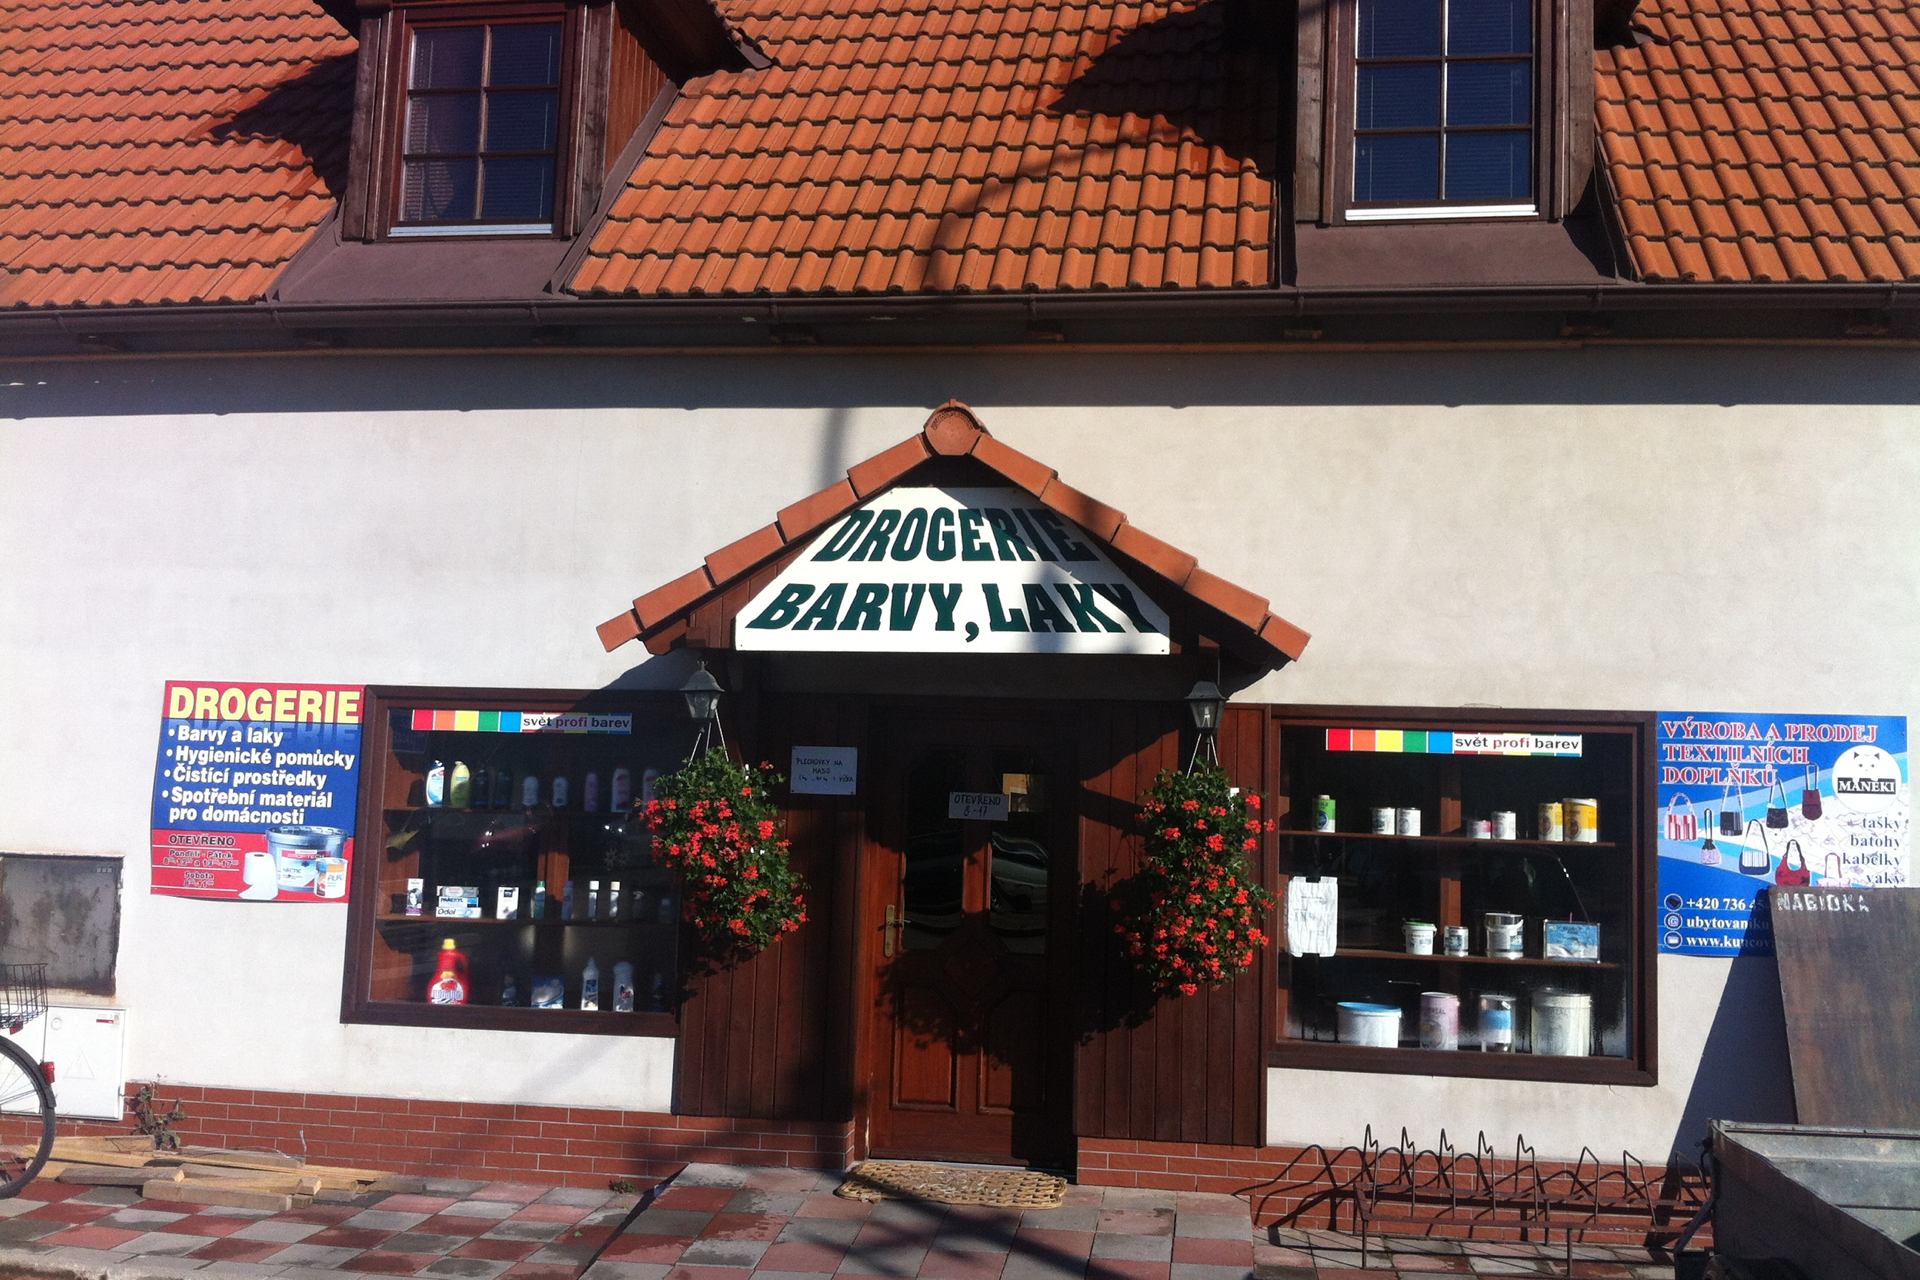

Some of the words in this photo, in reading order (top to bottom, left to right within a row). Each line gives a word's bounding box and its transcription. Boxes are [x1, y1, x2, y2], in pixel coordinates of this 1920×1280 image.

[809, 507, 1102, 562] DROGERIE
[169, 687, 361, 723] DROGERIE
[522, 716, 552, 727] svět
[555, 716, 588, 730] profi
[591, 717, 630, 728] barev
[1662, 716, 1762, 741] VÝROBA
[1763, 722, 1782, 741] A
[1784, 723, 1878, 743] PRODEJ
[177, 724, 227, 746] Barvy
[231, 729, 242, 743] a
[247, 727, 284, 747] laky
[1455, 736, 1489, 748] svět
[1492, 736, 1530, 752] profi
[1534, 737, 1580, 751] barev
[175, 745, 272, 766] Hygienické
[275, 749, 356, 771] pomůcky
[1662, 742, 1811, 765] TEXTILNÍCH
[172, 763, 230, 784] Čistící
[233, 769, 328, 791] prostředky
[1662, 763, 1778, 787] DOPLŇKŮ
[1837, 779, 1897, 794] MANEKI
[171, 785, 257, 807] Spotřební
[259, 790, 333, 809] materiál
[954, 793, 1001, 806] OTEVŘENO
[169, 808, 198, 825] pro
[201, 806, 305, 826] domácnosti
[1861, 816, 1901, 832] tašky
[169, 833, 235, 846] OTEVŘENO
[1850, 834, 1901, 850] batohy
[1842, 852, 1901, 869] kabelky
[1866, 872, 1901, 888] vaky
[1686, 897, 1719, 911] +420
[1722, 897, 1746, 911] 736
